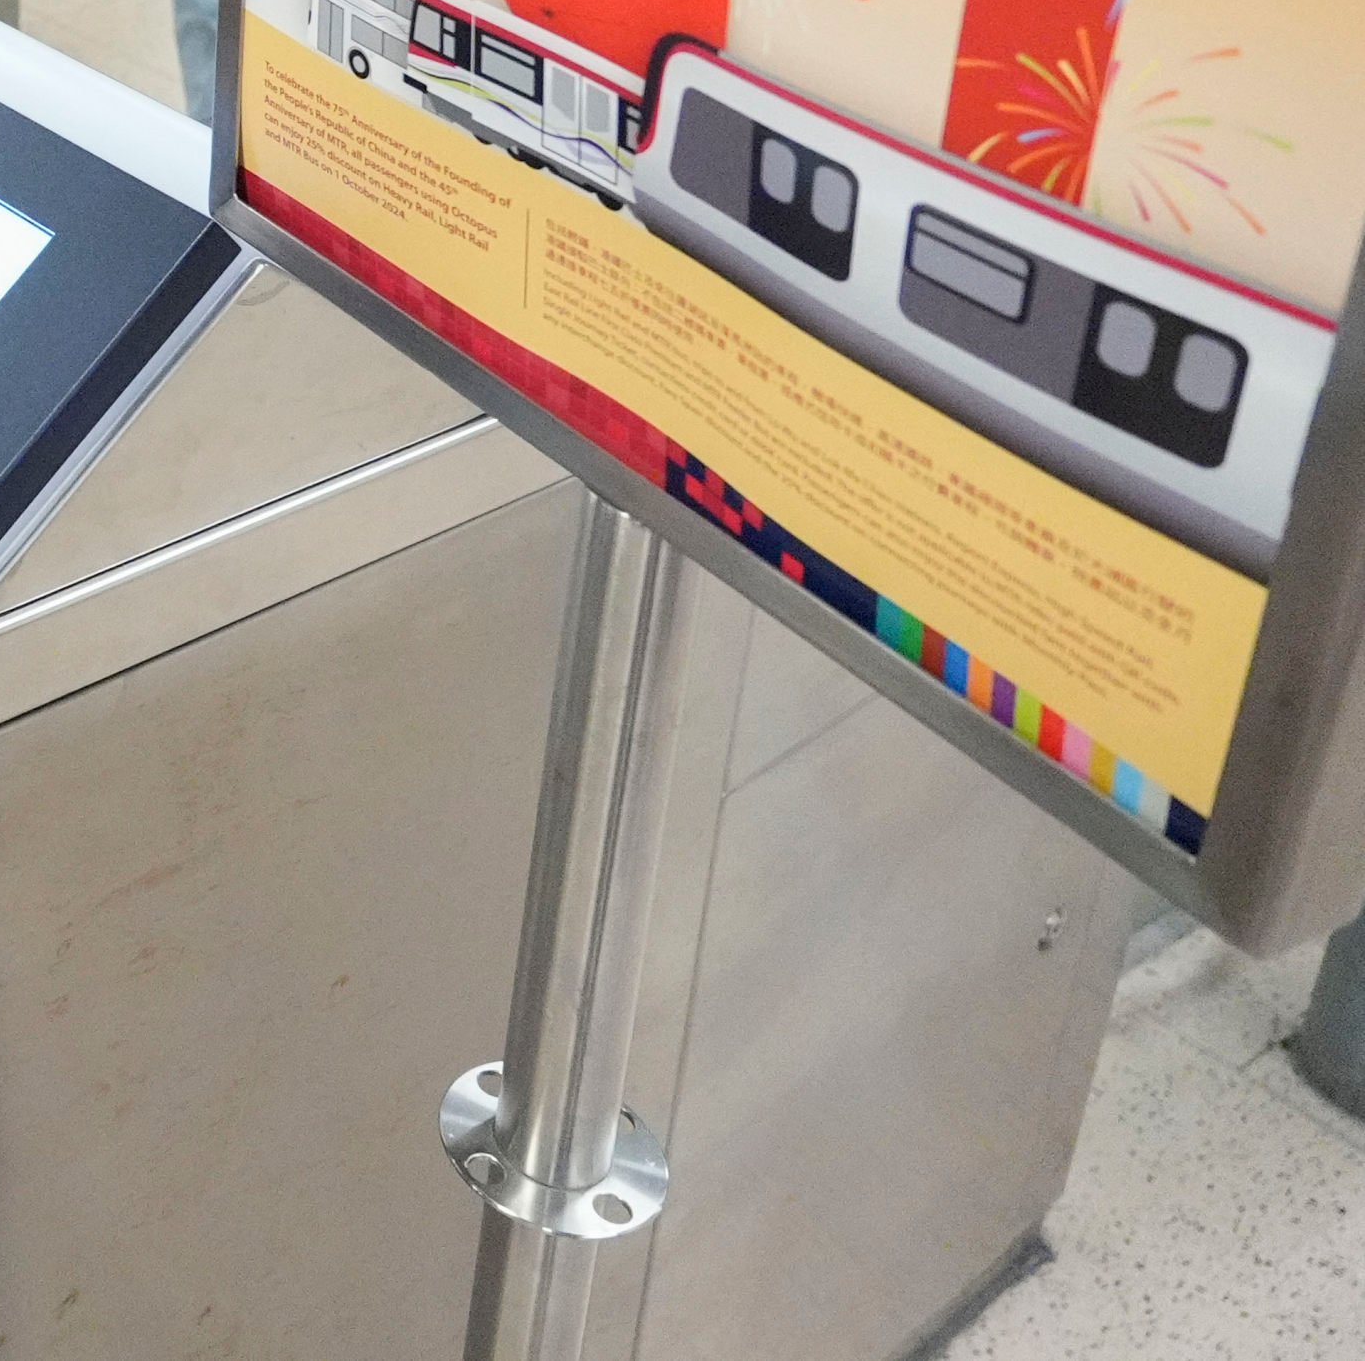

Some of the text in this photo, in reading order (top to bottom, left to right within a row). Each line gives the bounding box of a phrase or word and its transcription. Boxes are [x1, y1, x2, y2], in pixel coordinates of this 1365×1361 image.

[264, 78, 278, 94] the
[315, 109, 355, 140] Republic
[356, 135, 367, 147] of
[367, 140, 396, 164] China
[398, 161, 417, 176] and
[419, 170, 437, 188] the
[264, 94, 498, 239] Anniversary of MTR, all passengers using Octopus
[264, 112, 279, 127] can
[280, 122, 304, 144] enjoy
[327, 150, 367, 180] discount
[368, 176, 381, 189] on
[383, 182, 413, 210] Heavy
[438, 215, 467, 241] Light
[468, 231, 489, 252] Rail
[265, 60, 274, 74] To
[275, 70, 314, 99] celebrate
[316, 93, 331, 110] the
[351, 114, 409, 155] Anniversary
[411, 149, 422, 161] of
[424, 155, 441, 172] the
[443, 165, 497, 204] Founding
[499, 197, 512, 209] of
[265, 127, 281, 143] and
[282, 136, 302, 157] MTR
[303, 150, 319, 167] Bus
[342, 174, 380, 205] October
